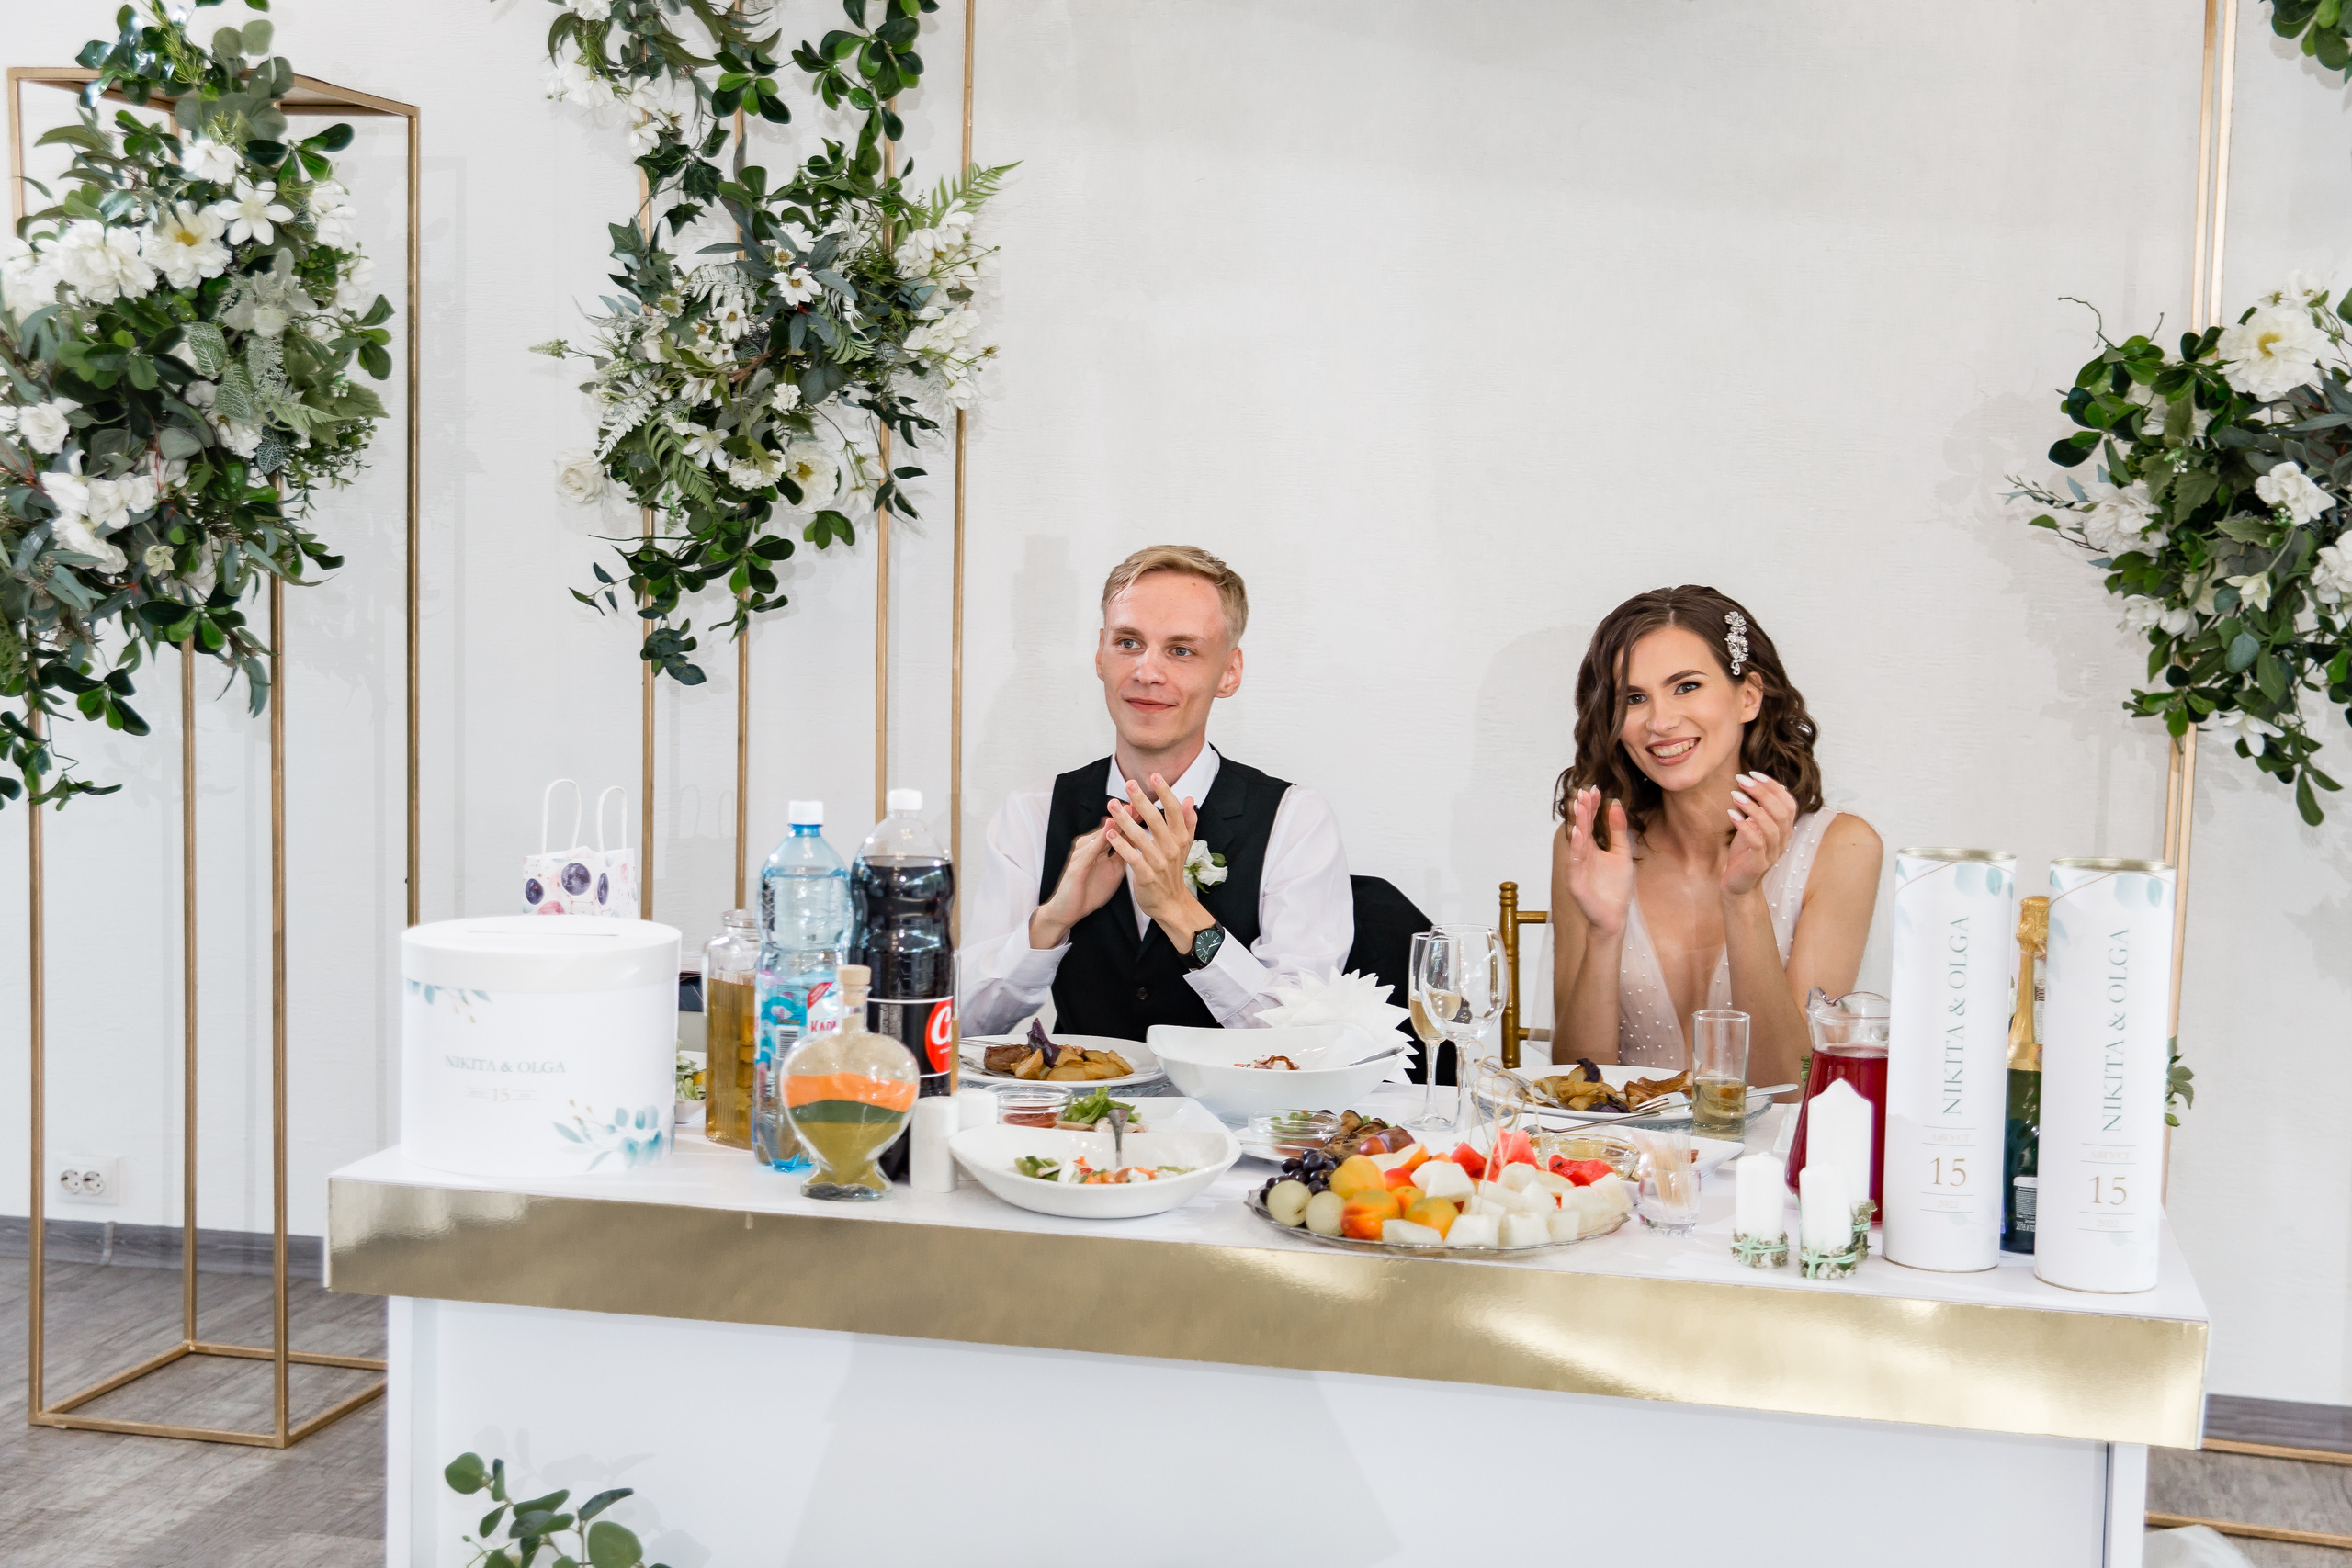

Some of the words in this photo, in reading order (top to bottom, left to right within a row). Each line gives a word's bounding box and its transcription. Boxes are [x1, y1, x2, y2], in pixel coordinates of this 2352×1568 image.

[1948, 917, 1969, 989] OLGA
[2107, 929, 2129, 1003] OLGA
[1948, 998, 1966, 1016] &
[2107, 1012, 2126, 1031] &
[445, 1055, 496, 1071] NIKITA
[500, 1061, 514, 1073] &
[517, 1061, 566, 1073] OLGA
[1942, 1024, 1964, 1115] NIKITA
[492, 1088, 510, 1101] 15
[2102, 1040, 2125, 1133] NIKITA
[1929, 1156, 1967, 1186] 15
[2088, 1176, 2127, 1205] 15
